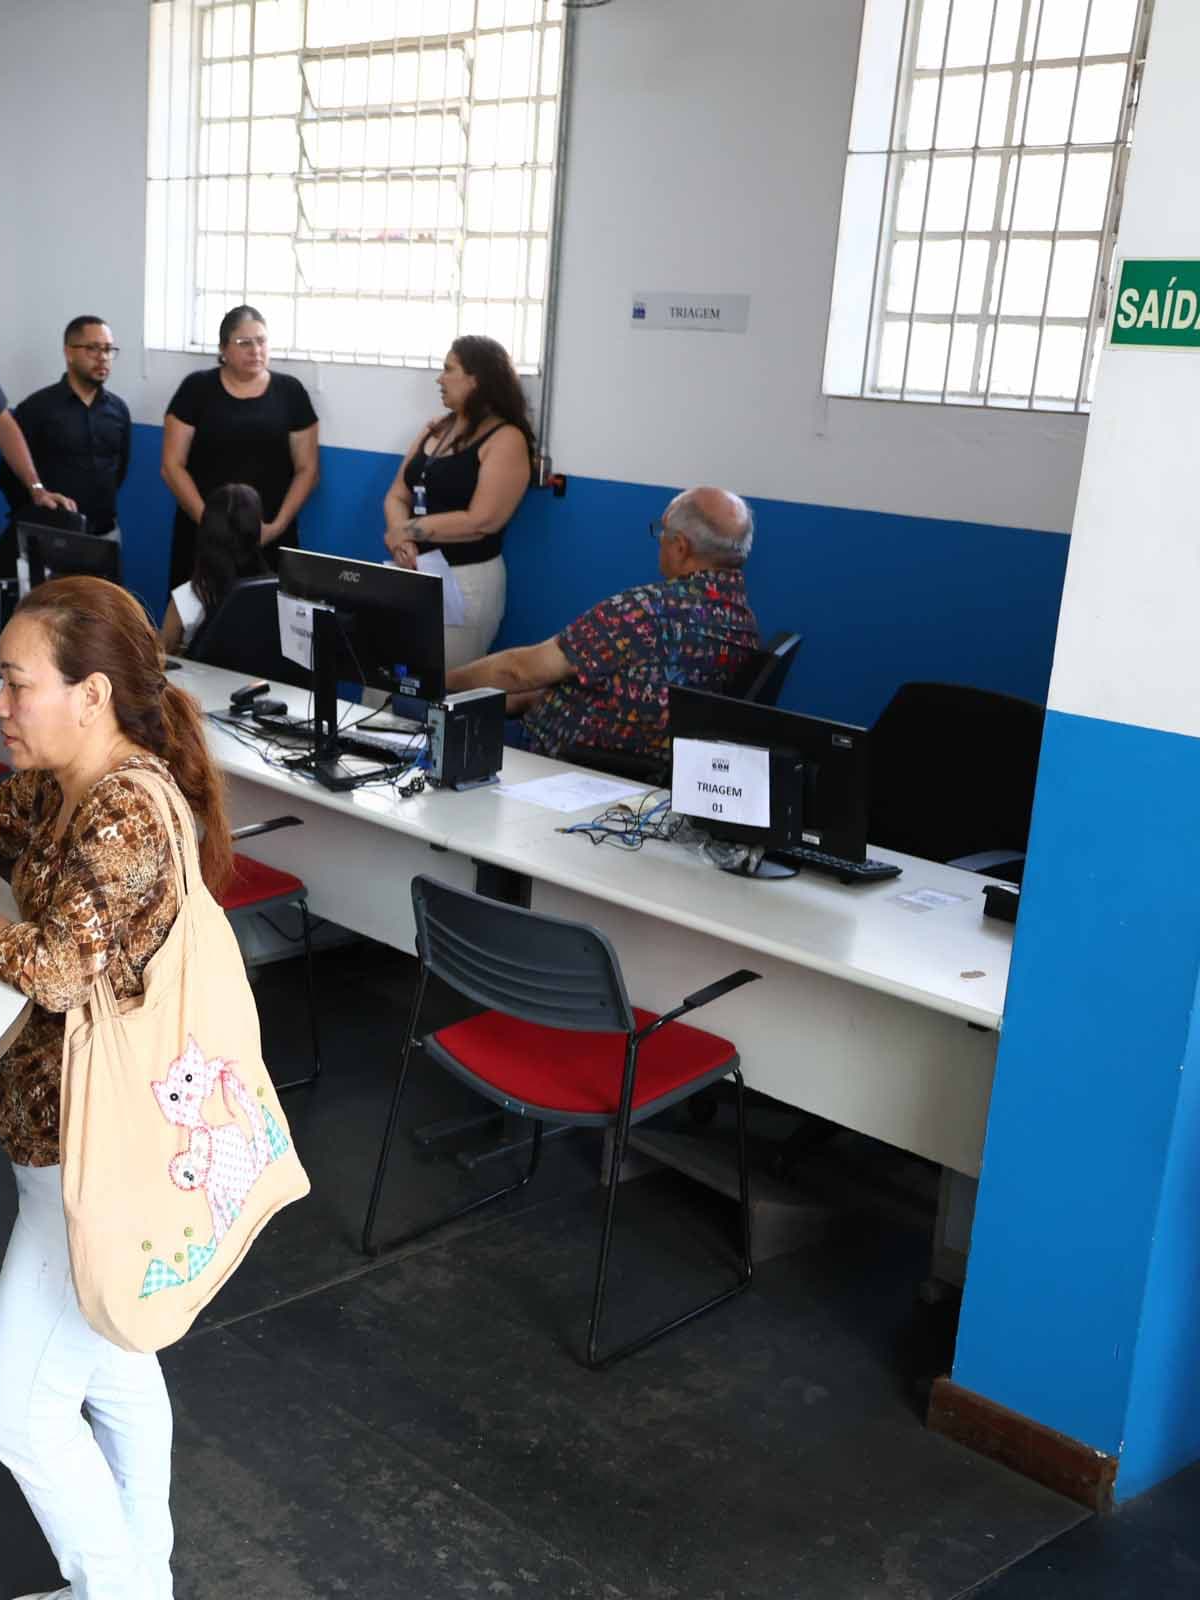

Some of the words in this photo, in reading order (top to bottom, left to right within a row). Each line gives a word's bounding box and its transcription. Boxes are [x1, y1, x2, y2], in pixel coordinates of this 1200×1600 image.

[1117, 276, 1200, 330] SAÍD
[669, 306, 721, 320] TRIAGEM
[697, 782, 742, 798] TRIAGEM
[712, 802, 723, 814] 01
